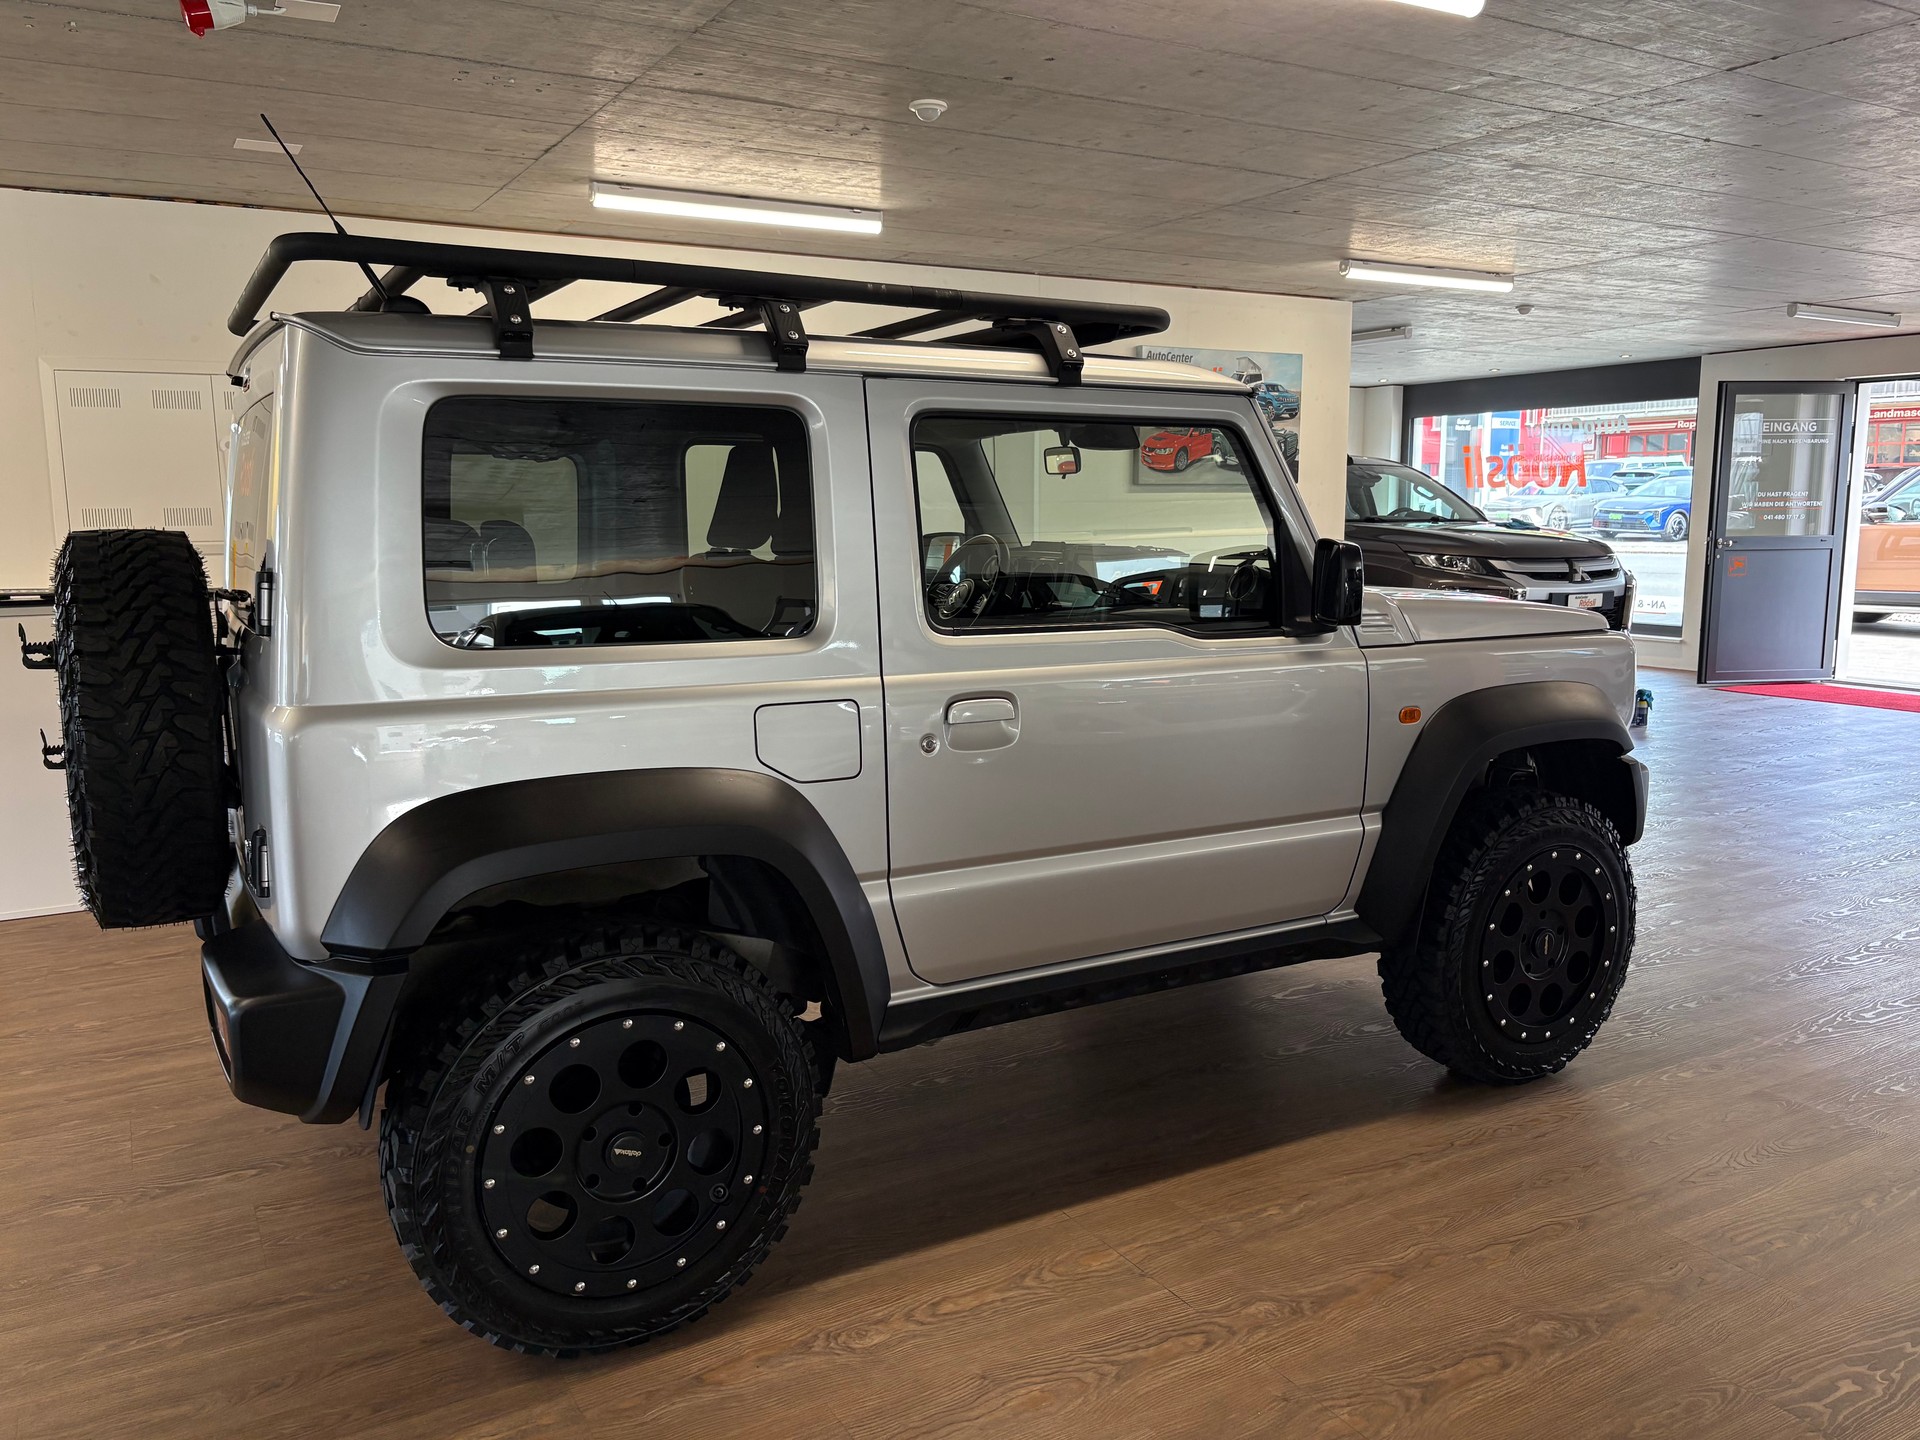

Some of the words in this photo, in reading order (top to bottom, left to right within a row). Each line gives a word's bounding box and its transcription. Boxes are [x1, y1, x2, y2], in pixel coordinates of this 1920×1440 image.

[1147, 350, 1193, 363] AutoCenter
[1763, 422, 1817, 432] EINGANG
[474, 1031, 525, 1096] M/T
